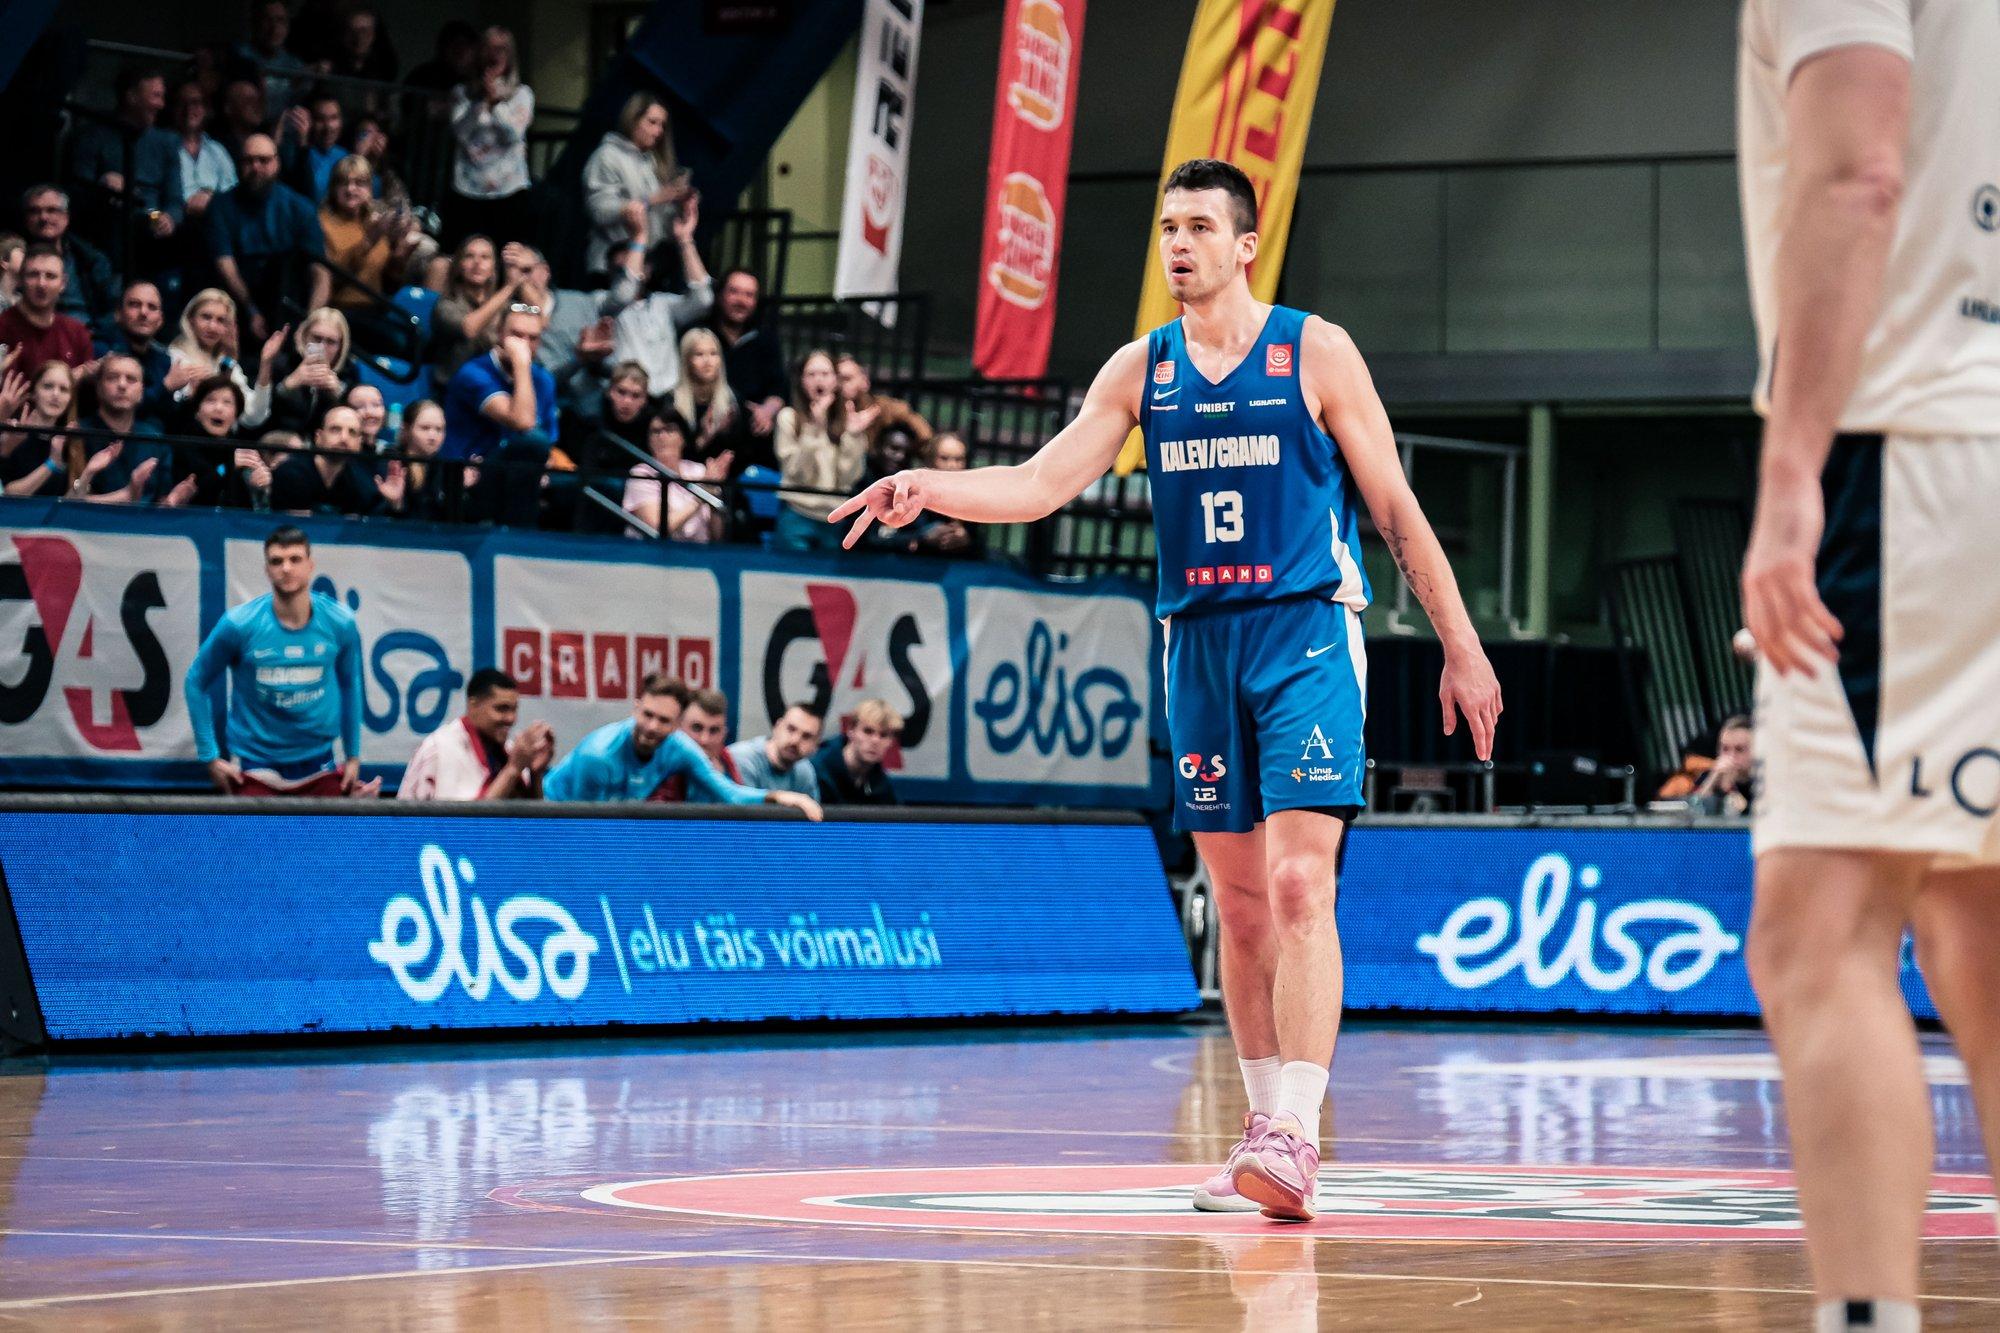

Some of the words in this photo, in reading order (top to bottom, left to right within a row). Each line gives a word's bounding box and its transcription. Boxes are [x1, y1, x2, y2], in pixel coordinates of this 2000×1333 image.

[1194, 401, 1236, 413] UNIBET
[1249, 398, 1287, 407] LIGNATOR
[1160, 434, 1280, 473] KALEV/CRAMO
[1200, 490, 1245, 544] 13
[1187, 567, 1270, 583] CRAMO
[974, 619, 1142, 760] elisa
[1179, 752, 1227, 783] G4S
[1308, 767, 1333, 775] Linus
[1308, 773, 1343, 782] Medical
[367, 842, 600, 1002] elisa
[629, 901, 691, 972] elu
[693, 912, 766, 971] täis
[767, 900, 943, 970] võimalusi
[1415, 851, 1741, 992] elisa
